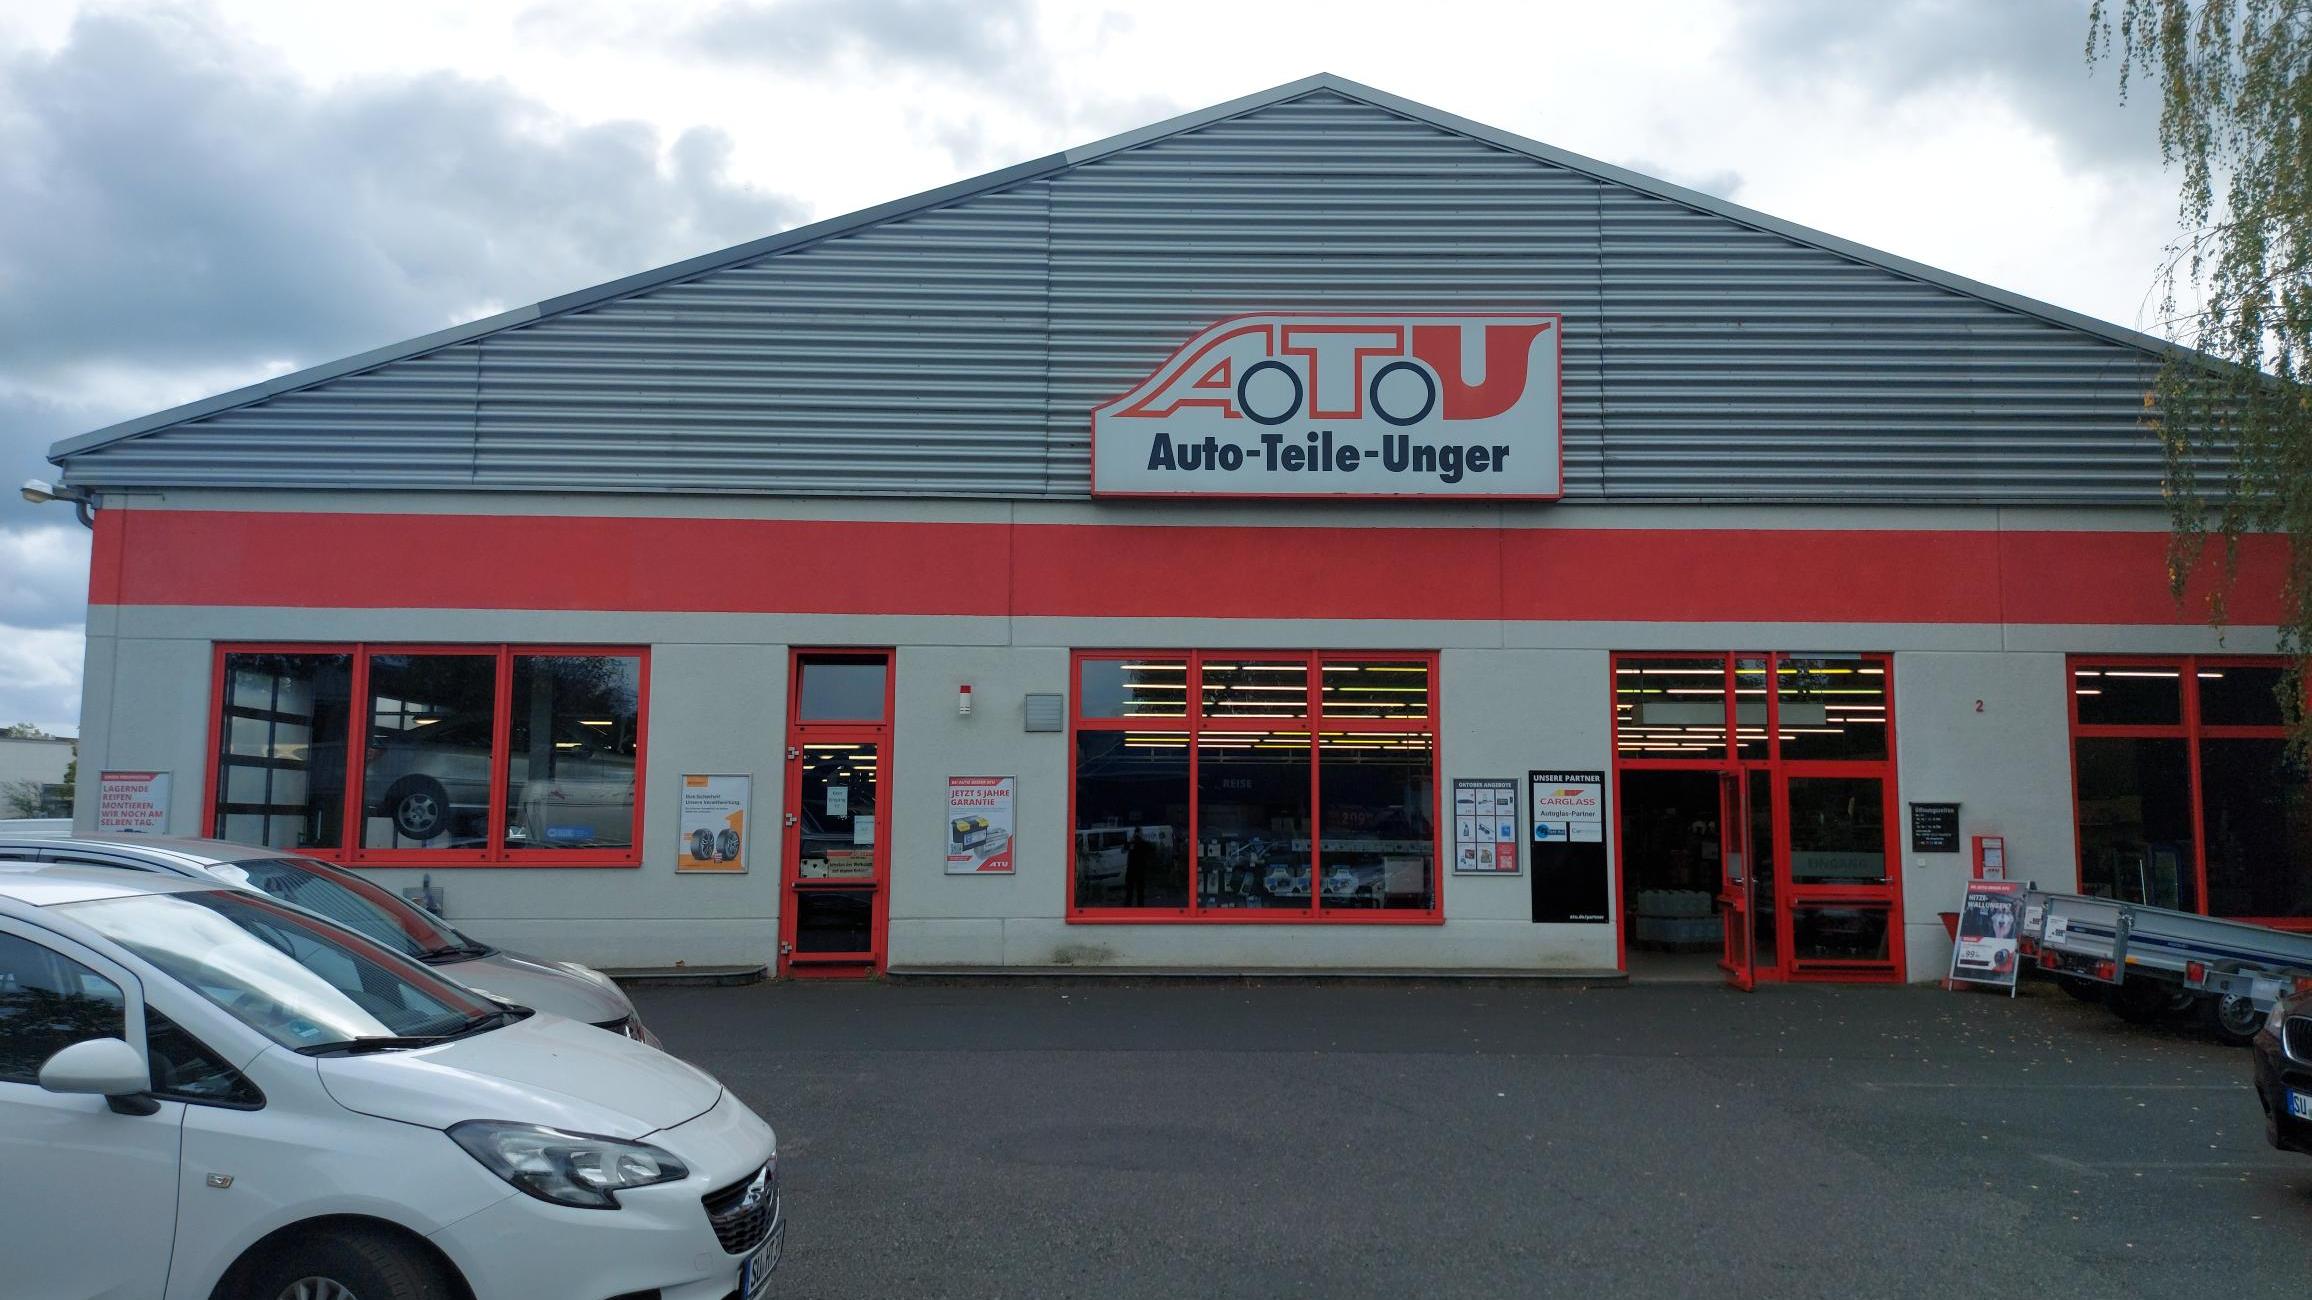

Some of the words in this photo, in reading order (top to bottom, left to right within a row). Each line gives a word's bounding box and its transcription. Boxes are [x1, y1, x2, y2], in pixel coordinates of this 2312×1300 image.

[1147, 430, 1510, 484] Auto-Teile-Unger
[1975, 699, 1984, 712] 2
[1533, 774, 1563, 782] UNSERE
[103, 785, 149, 793] LAGERNDE
[951, 790, 974, 798] JETZT
[983, 790, 1010, 798] JAHRE
[1540, 798, 1596, 806] CARGLASS
[101, 818, 132, 826] SELBEN
[135, 818, 154, 826] TAG.
[2294, 1095, 2307, 1115] SU
